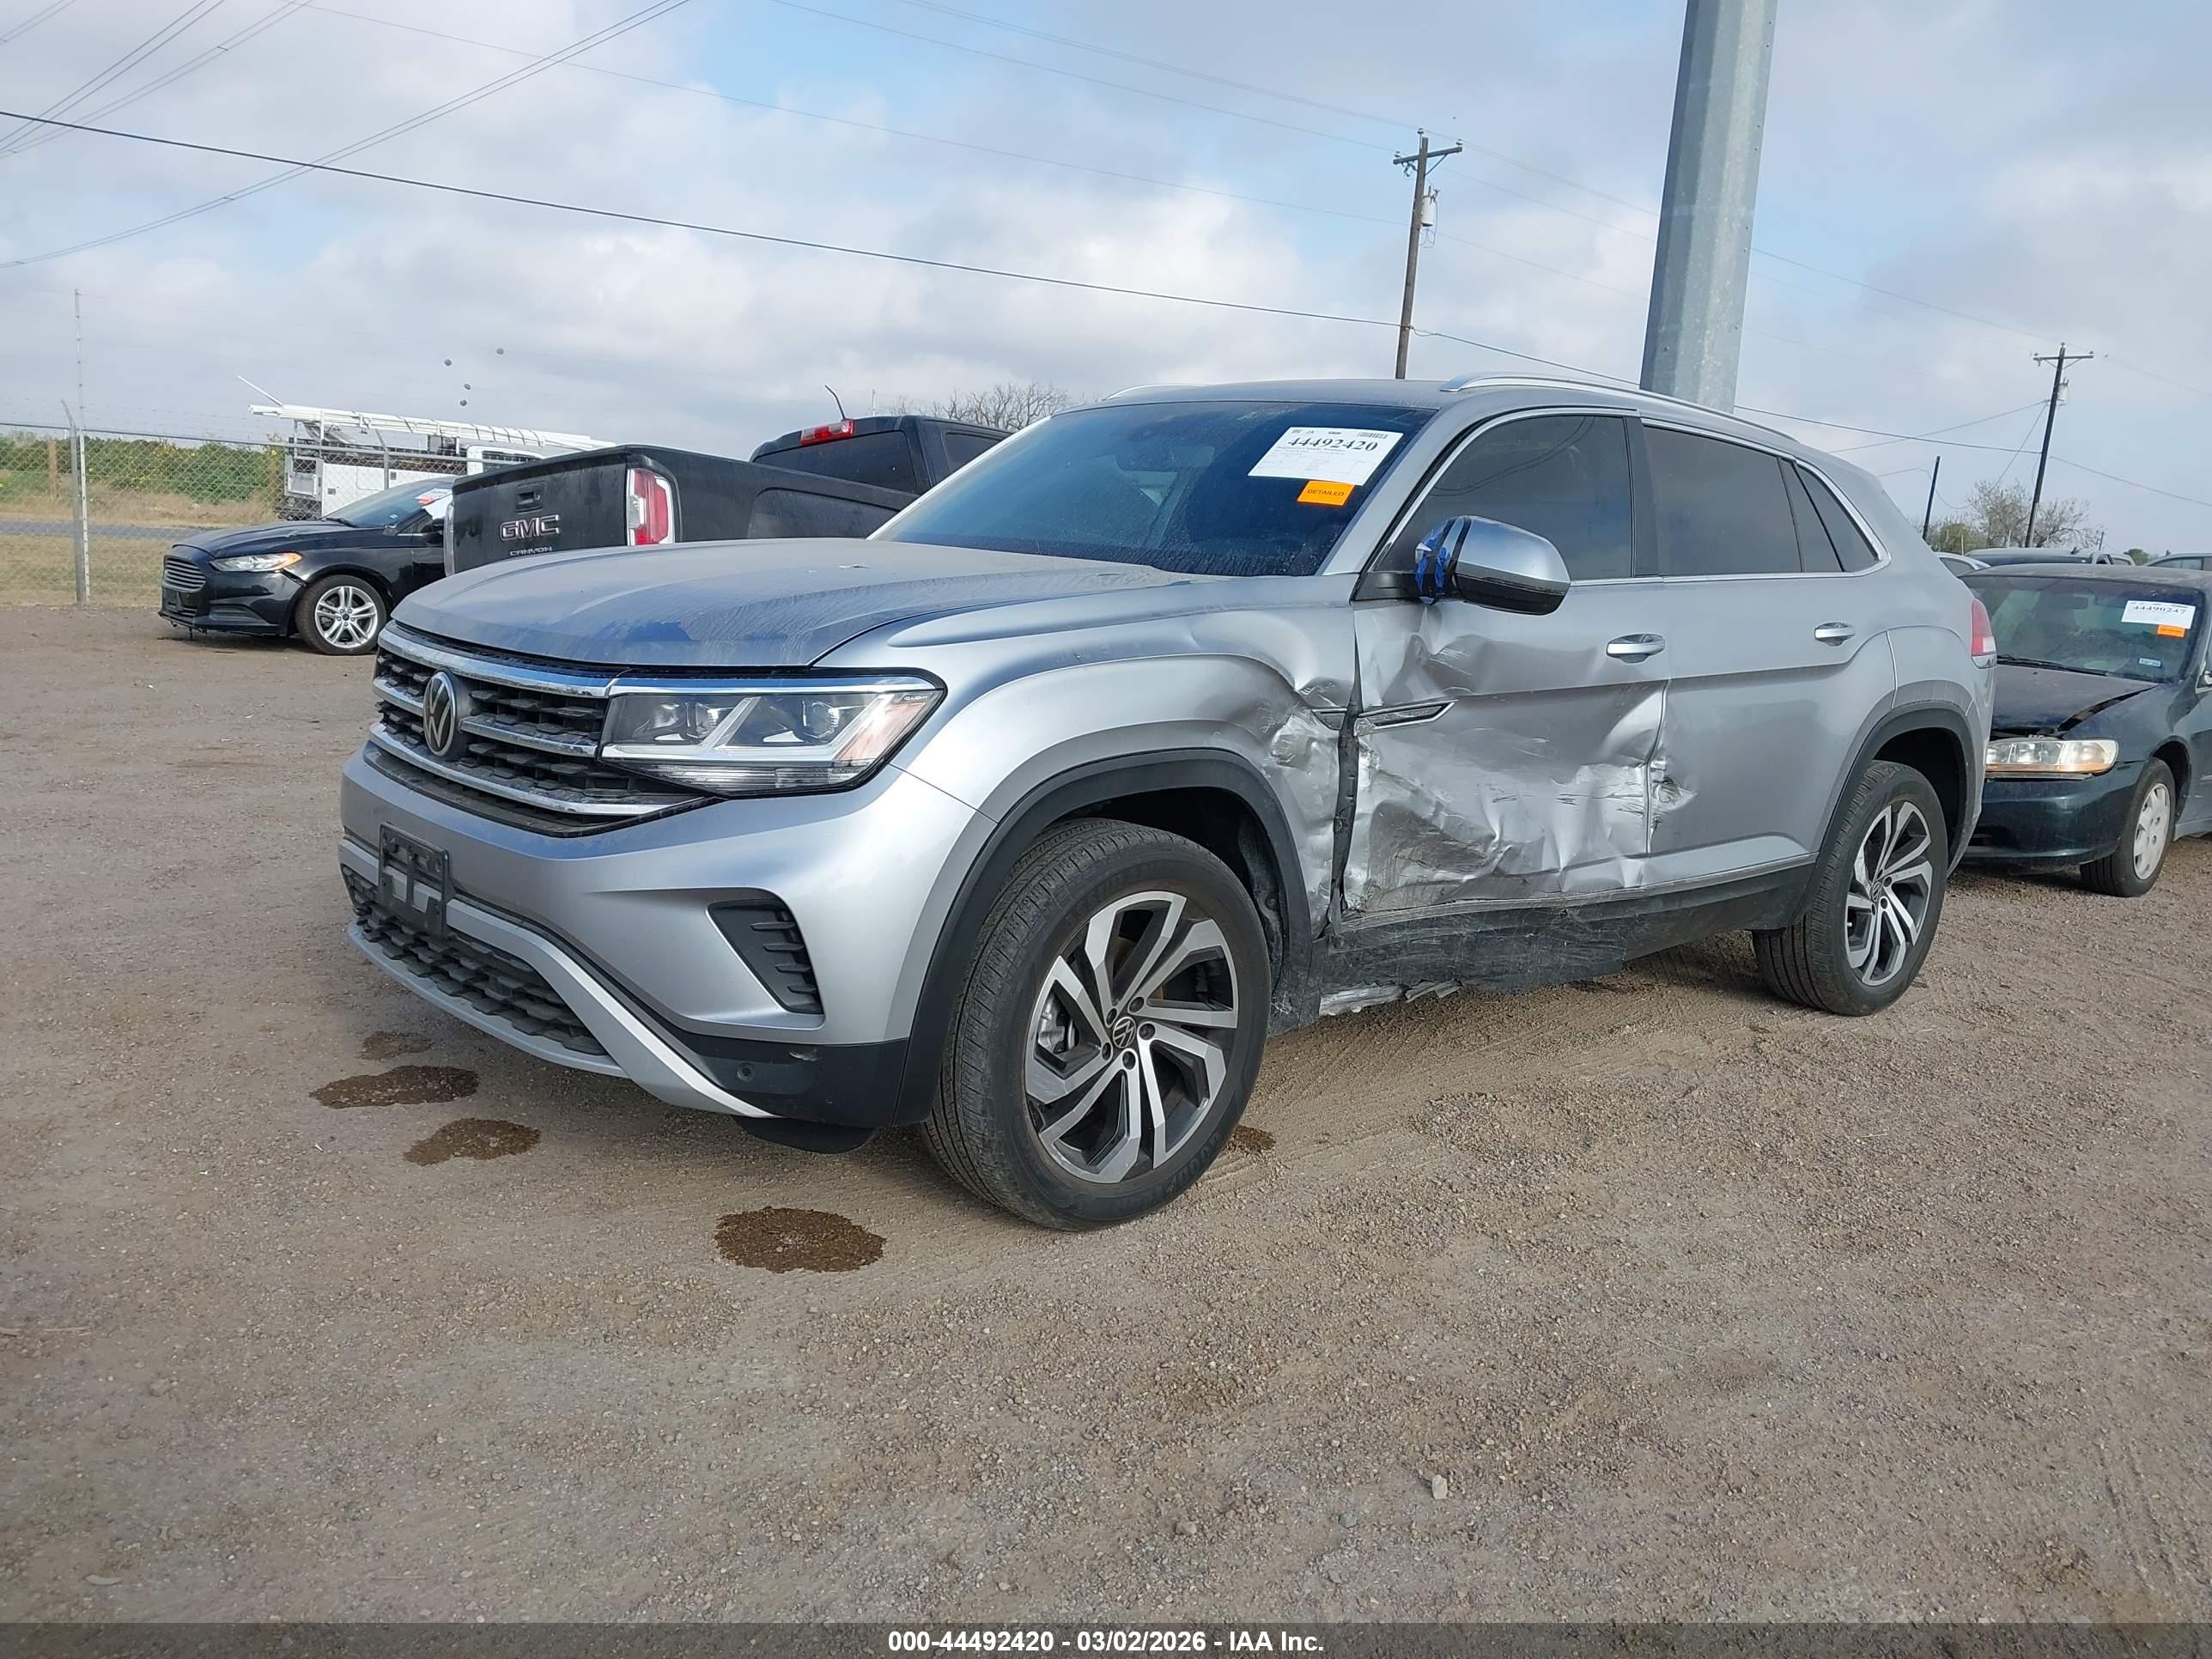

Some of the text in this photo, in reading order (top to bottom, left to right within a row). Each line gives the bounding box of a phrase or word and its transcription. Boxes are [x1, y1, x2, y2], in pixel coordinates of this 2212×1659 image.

[1288, 436, 1378, 452] 44492420
[500, 514, 559, 541] GMC
[510, 546, 552, 556] CANYON
[2134, 605, 2186, 614] 44490247
